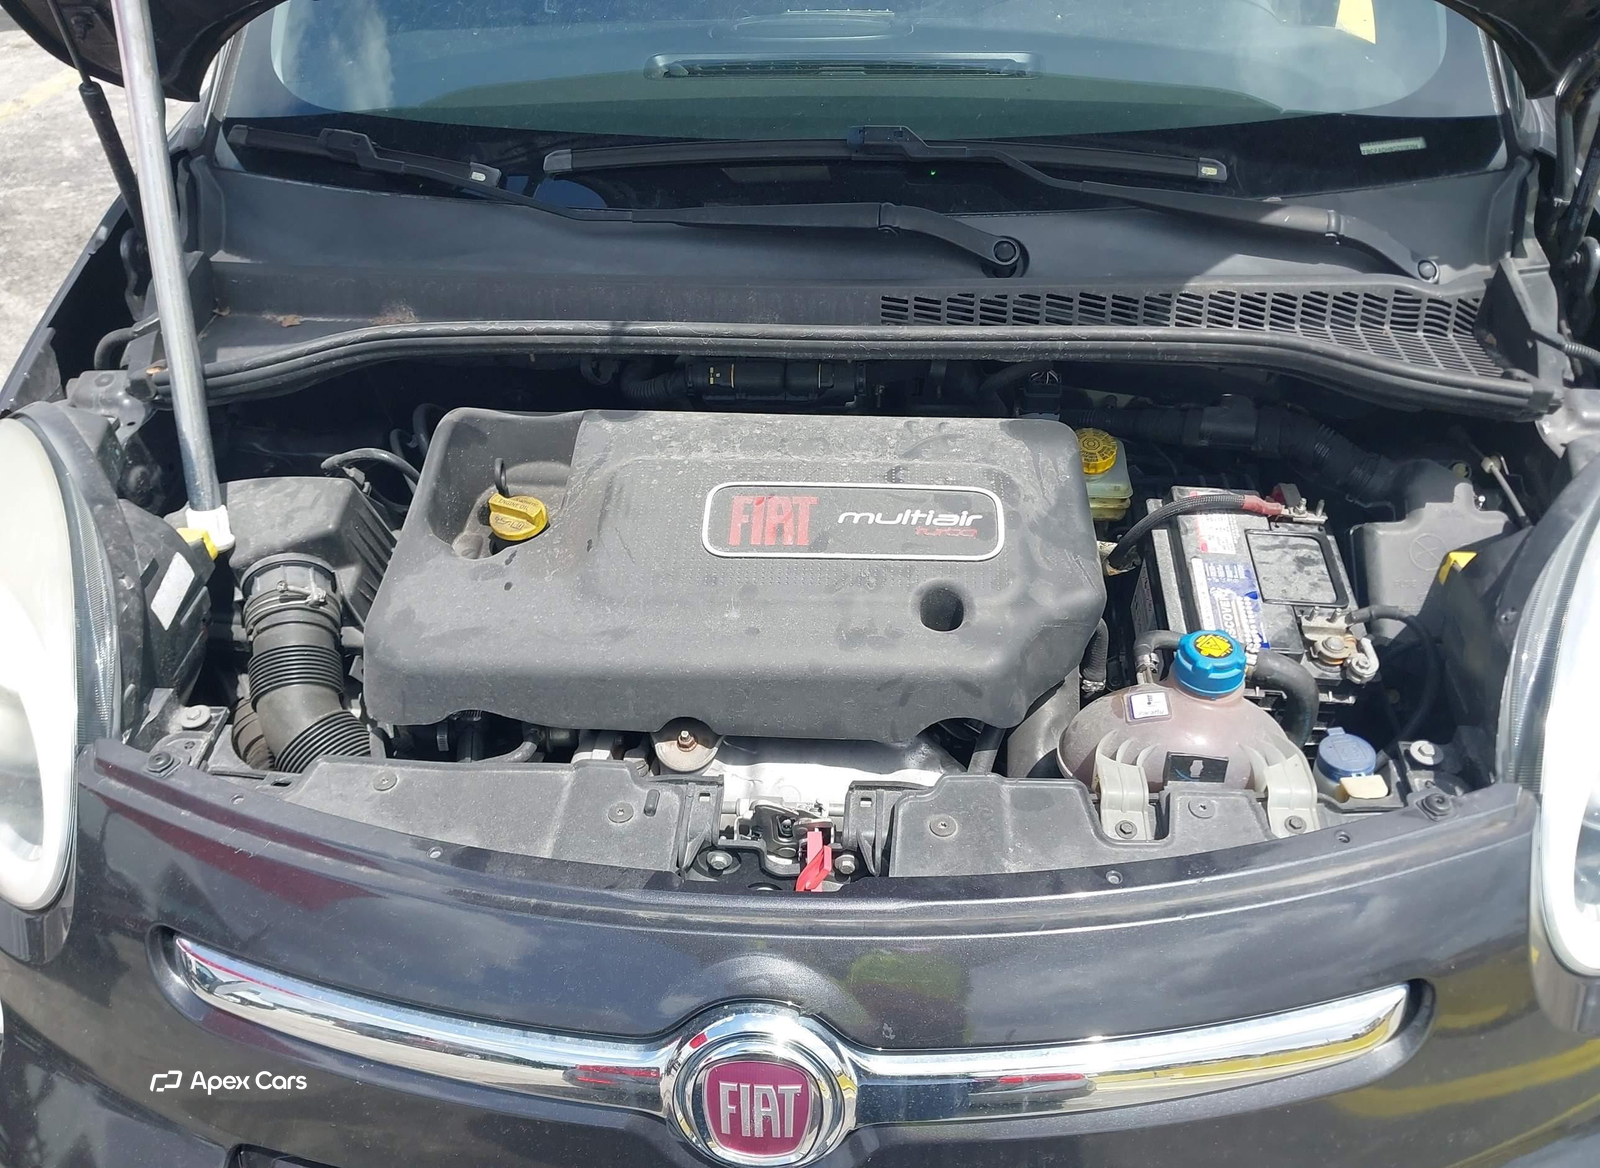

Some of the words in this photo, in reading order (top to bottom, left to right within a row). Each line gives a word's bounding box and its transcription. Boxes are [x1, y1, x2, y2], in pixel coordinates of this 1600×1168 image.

[727, 496, 819, 546] FIAT
[838, 509, 983, 526] multiair
[719, 1080, 802, 1138] FIAT
